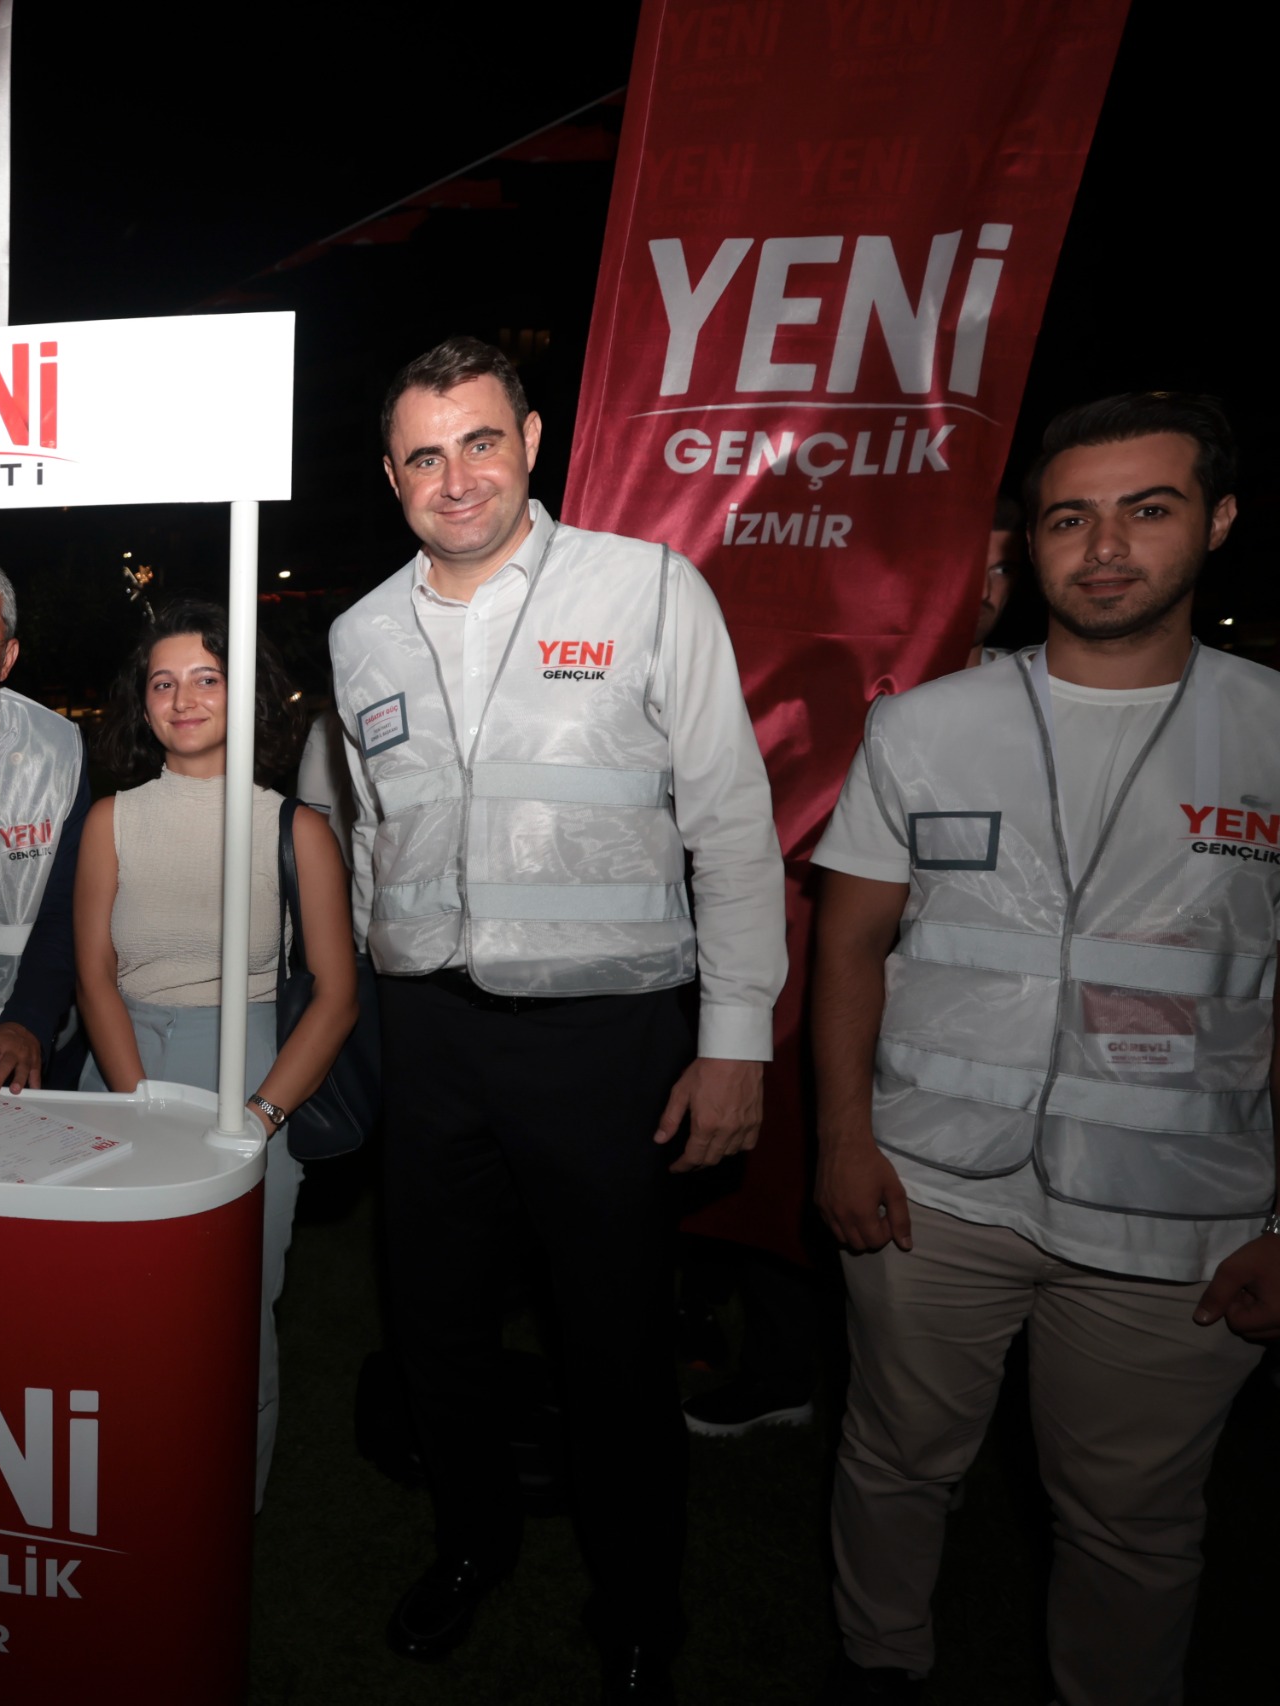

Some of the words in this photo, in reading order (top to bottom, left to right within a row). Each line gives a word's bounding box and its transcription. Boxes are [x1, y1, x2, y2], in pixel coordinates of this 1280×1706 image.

[663, 416, 956, 491] GENÇLİK
[722, 503, 853, 548] İZMİR
[543, 670, 605, 682] GENÇLİK
[1180, 804, 1280, 845] YEN
